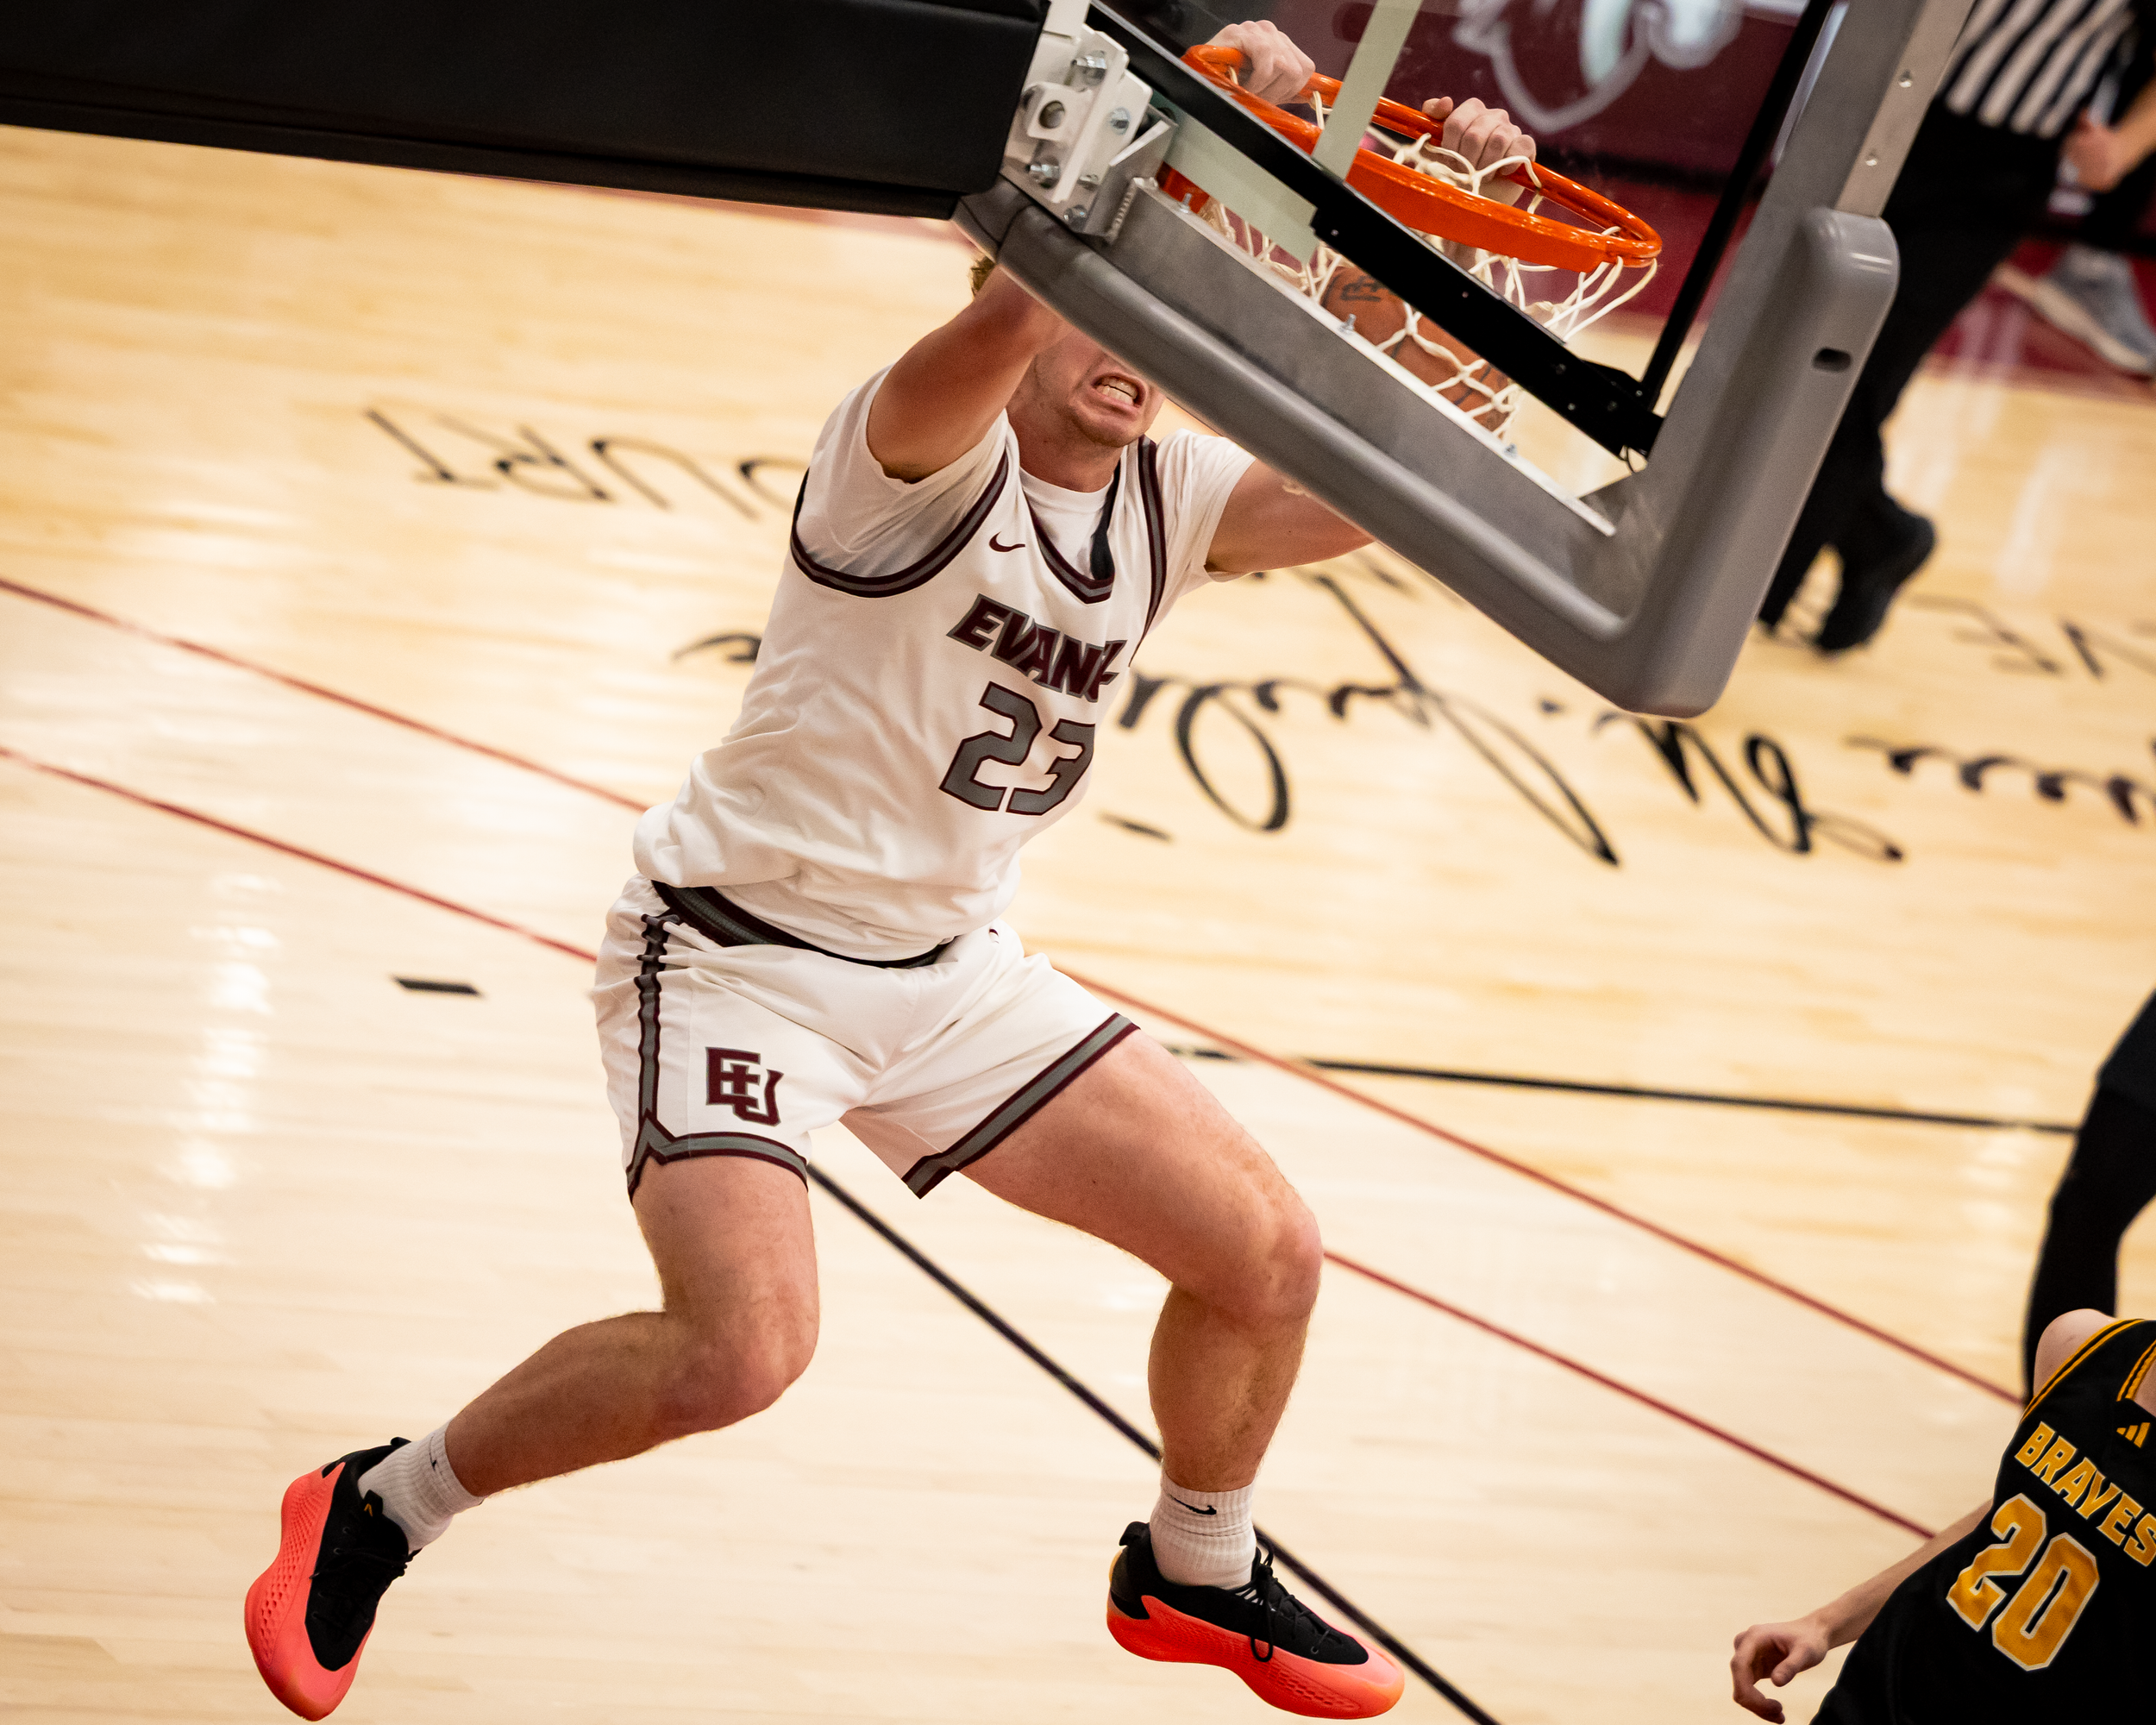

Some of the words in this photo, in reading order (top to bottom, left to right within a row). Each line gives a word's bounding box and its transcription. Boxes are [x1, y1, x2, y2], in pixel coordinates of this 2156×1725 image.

[938, 681, 1096, 816] 23
[705, 1045, 784, 1127] EU
[2015, 1421, 2156, 1567] BRAVES
[1946, 1492, 2100, 1672] 20
